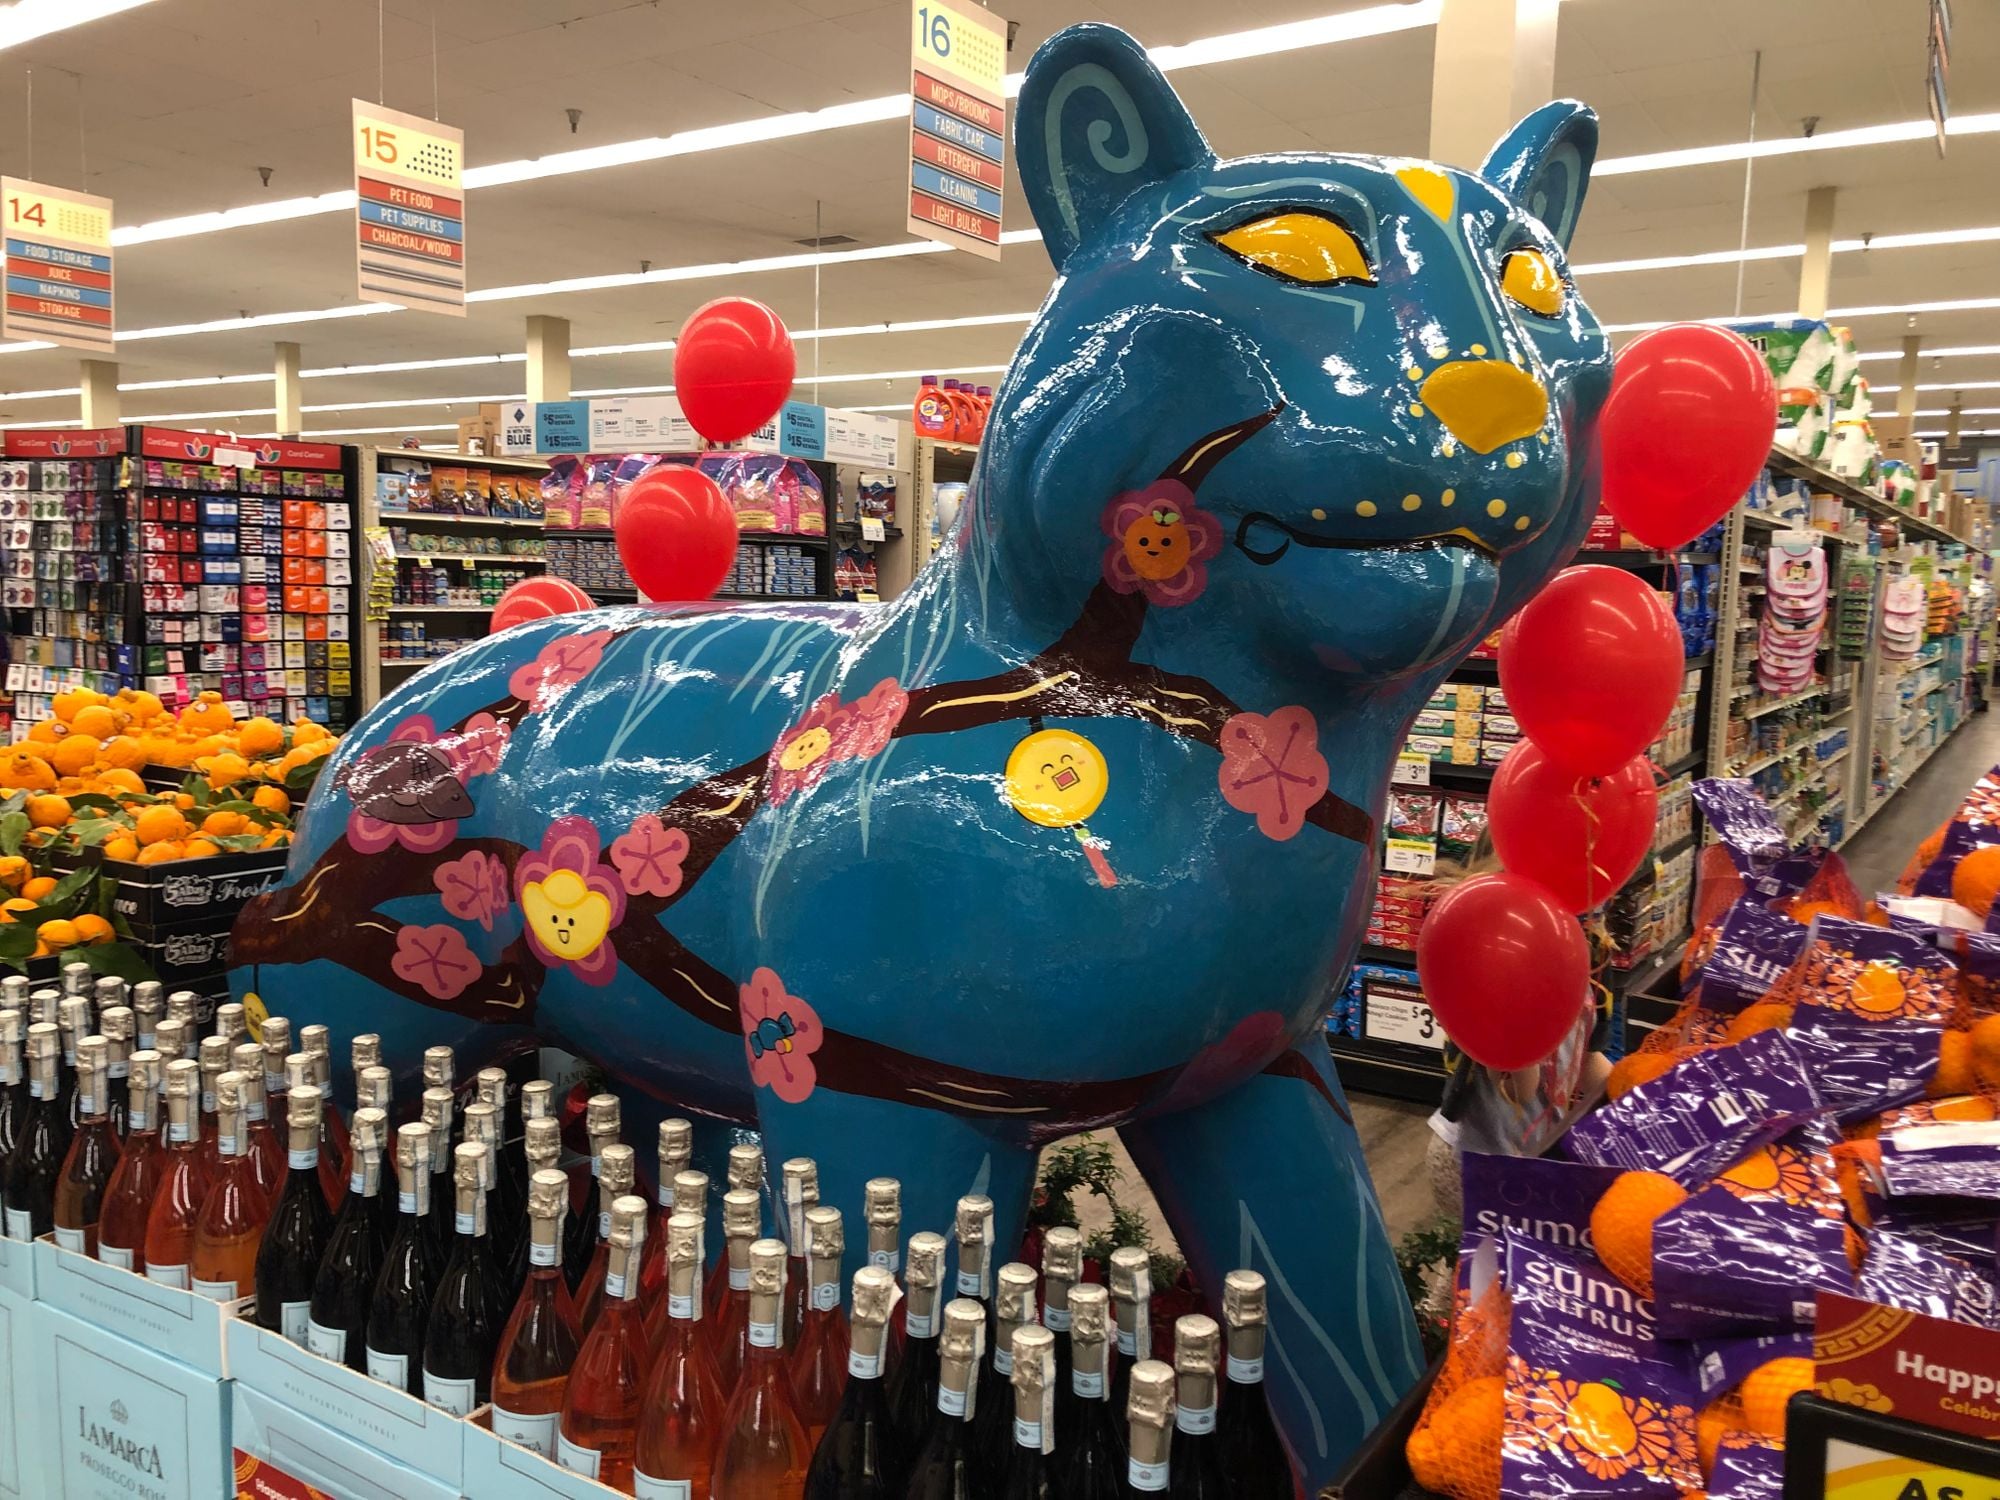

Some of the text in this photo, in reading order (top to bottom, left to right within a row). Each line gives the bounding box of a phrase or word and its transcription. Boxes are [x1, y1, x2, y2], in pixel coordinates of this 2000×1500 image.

[918, 8, 950, 58] 16
[931, 82, 991, 124] MOPS/BROOMS
[360, 126, 398, 164] 15
[935, 115, 984, 150] FABRIC CARE
[938, 146, 981, 178] DETERGENT
[390, 188, 434, 210] PET FOOD
[940, 176, 978, 205] CLEANING
[8, 198, 46, 228] 14
[380, 208, 444, 234] PET SUPPLIES
[932, 204, 982, 235] LIGHT BULBS
[24, 244, 93, 268] FOOD STORAGE
[372, 228, 452, 257] CHARCOAL/WOOD
[48, 267, 73, 280] JUICE
[38, 283, 81, 300] NAPKINS
[38, 302, 81, 318] STORAGE
[544, 414, 554, 426] $5
[786, 412, 797, 426] $5
[506, 434, 532, 446] BLUE
[545, 435, 560, 448] $15
[787, 434, 802, 448] $15
[288, 450, 325, 459] Card Center
[1539, 1290, 1655, 1342] CITRUS
[1896, 1350, 2000, 1404] Happ
[80, 1451, 136, 1492] PROSECCO
